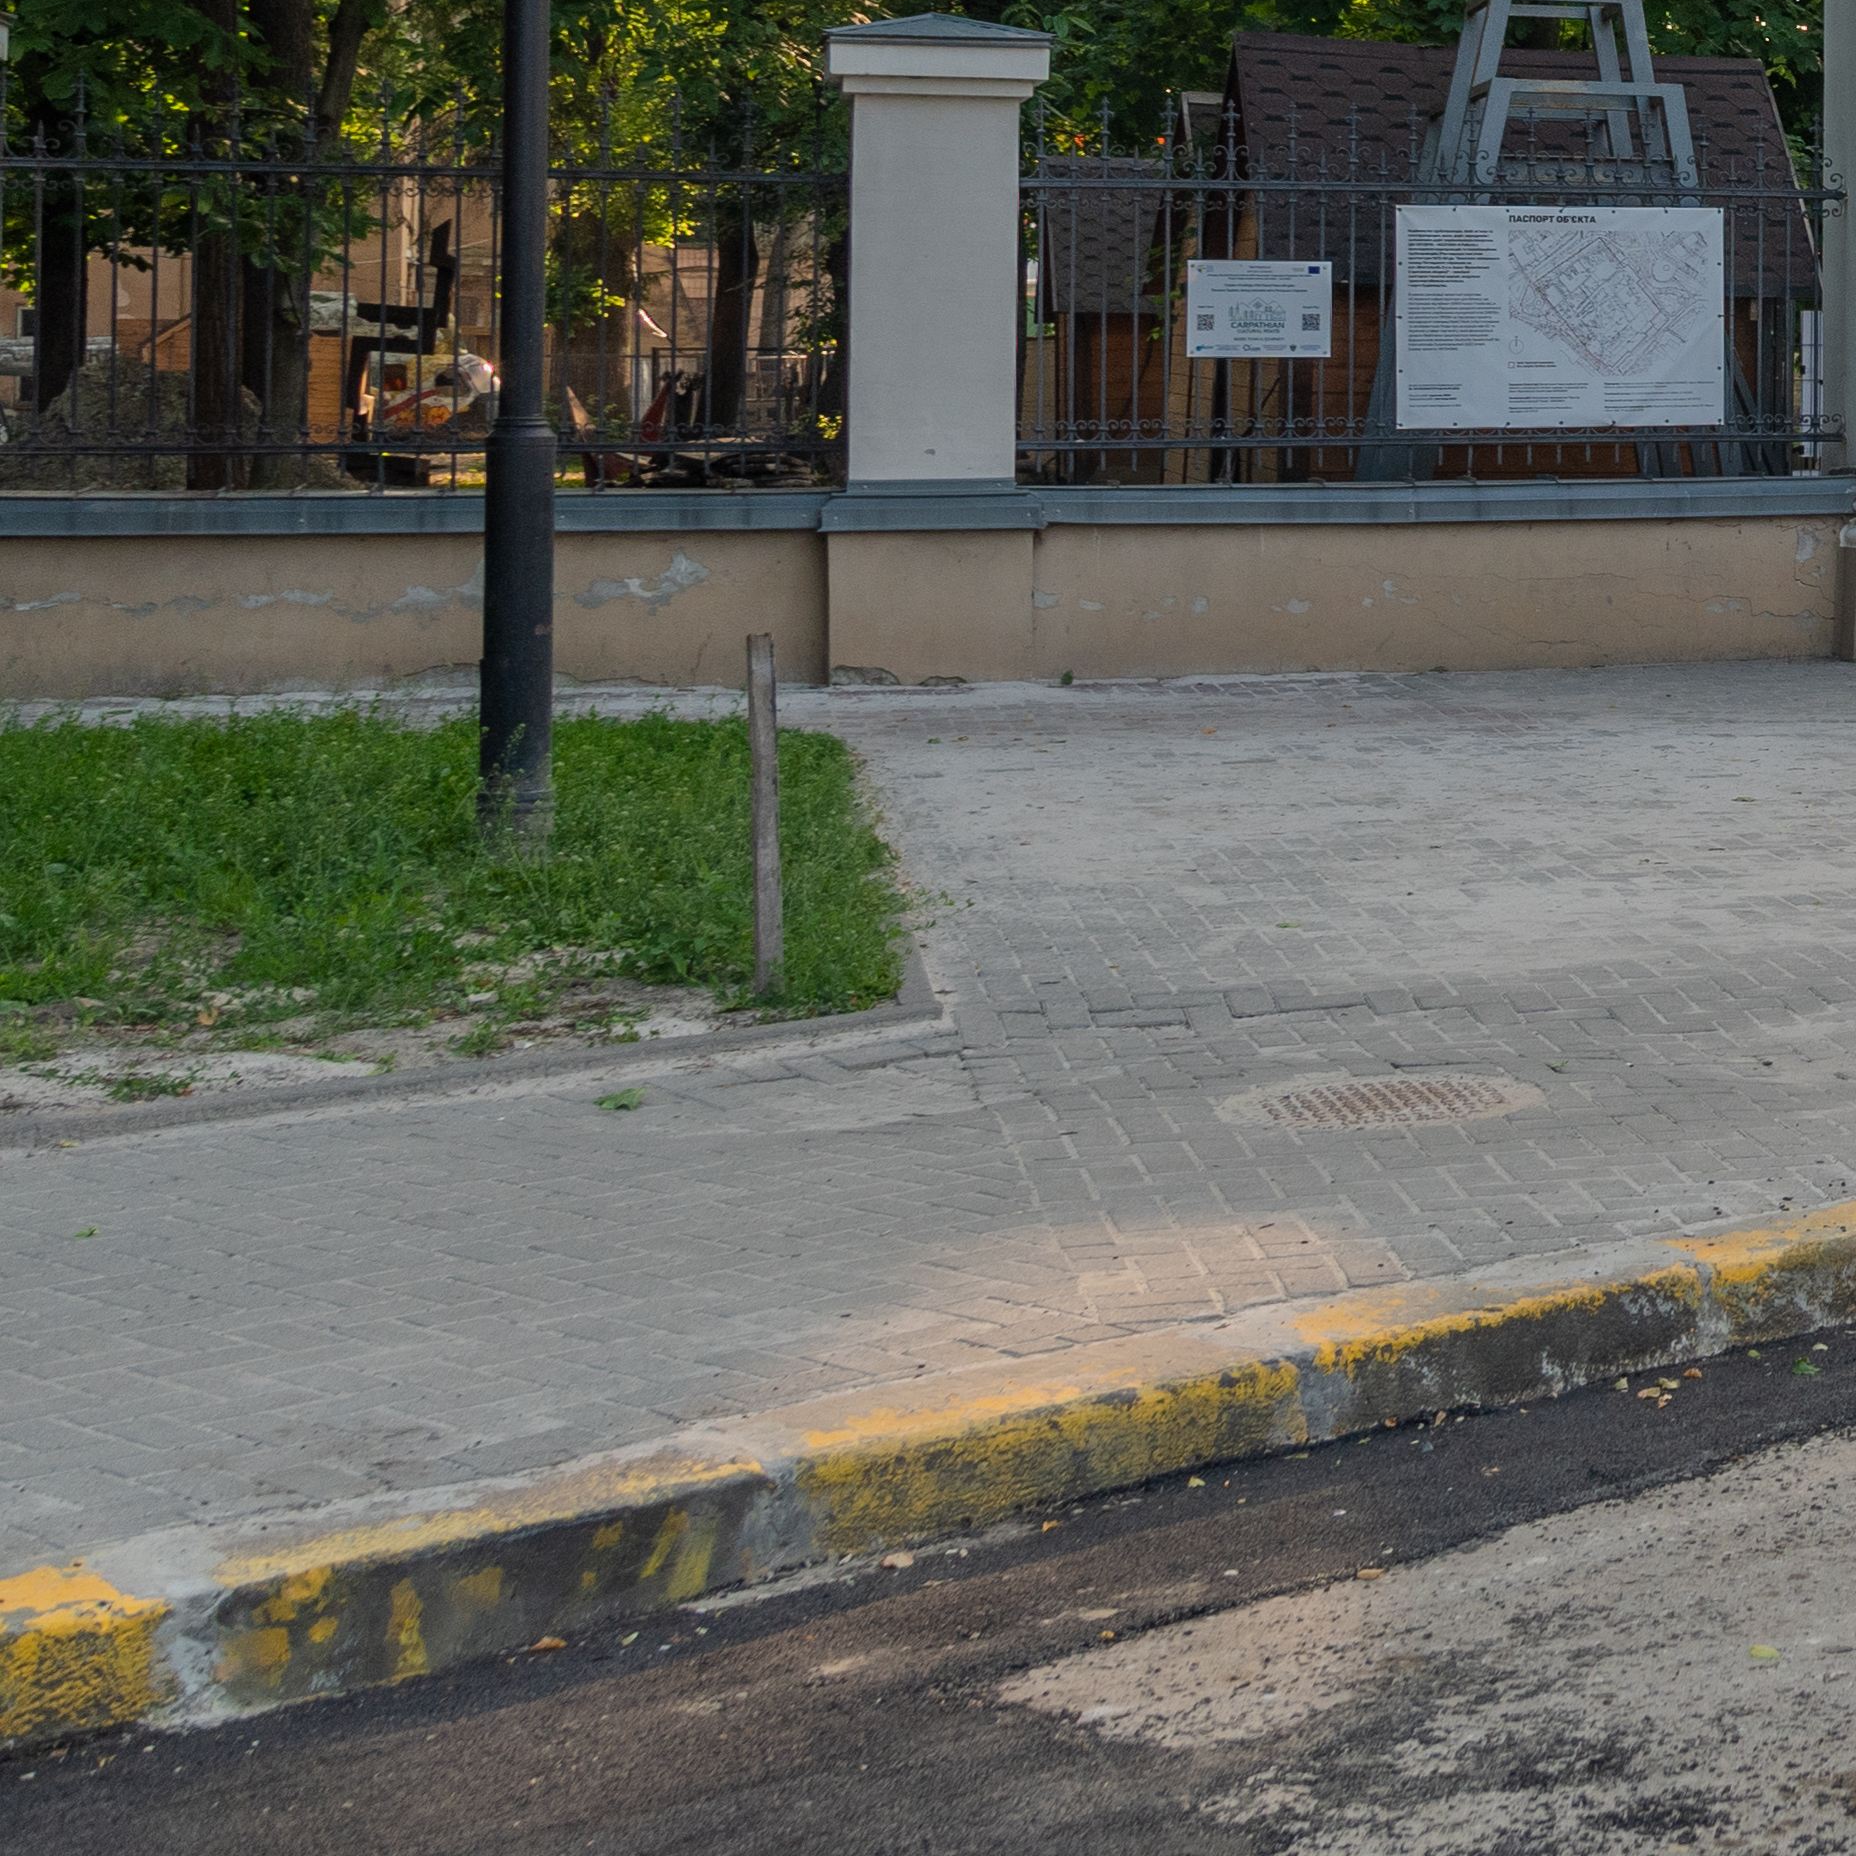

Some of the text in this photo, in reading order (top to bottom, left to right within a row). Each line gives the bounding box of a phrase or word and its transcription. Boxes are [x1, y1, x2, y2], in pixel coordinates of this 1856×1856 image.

[1509, 215, 1596, 224] ПАСПОРТ ОБ'ЄКТА
[1231, 321, 1285, 329] CARPATHIAN
